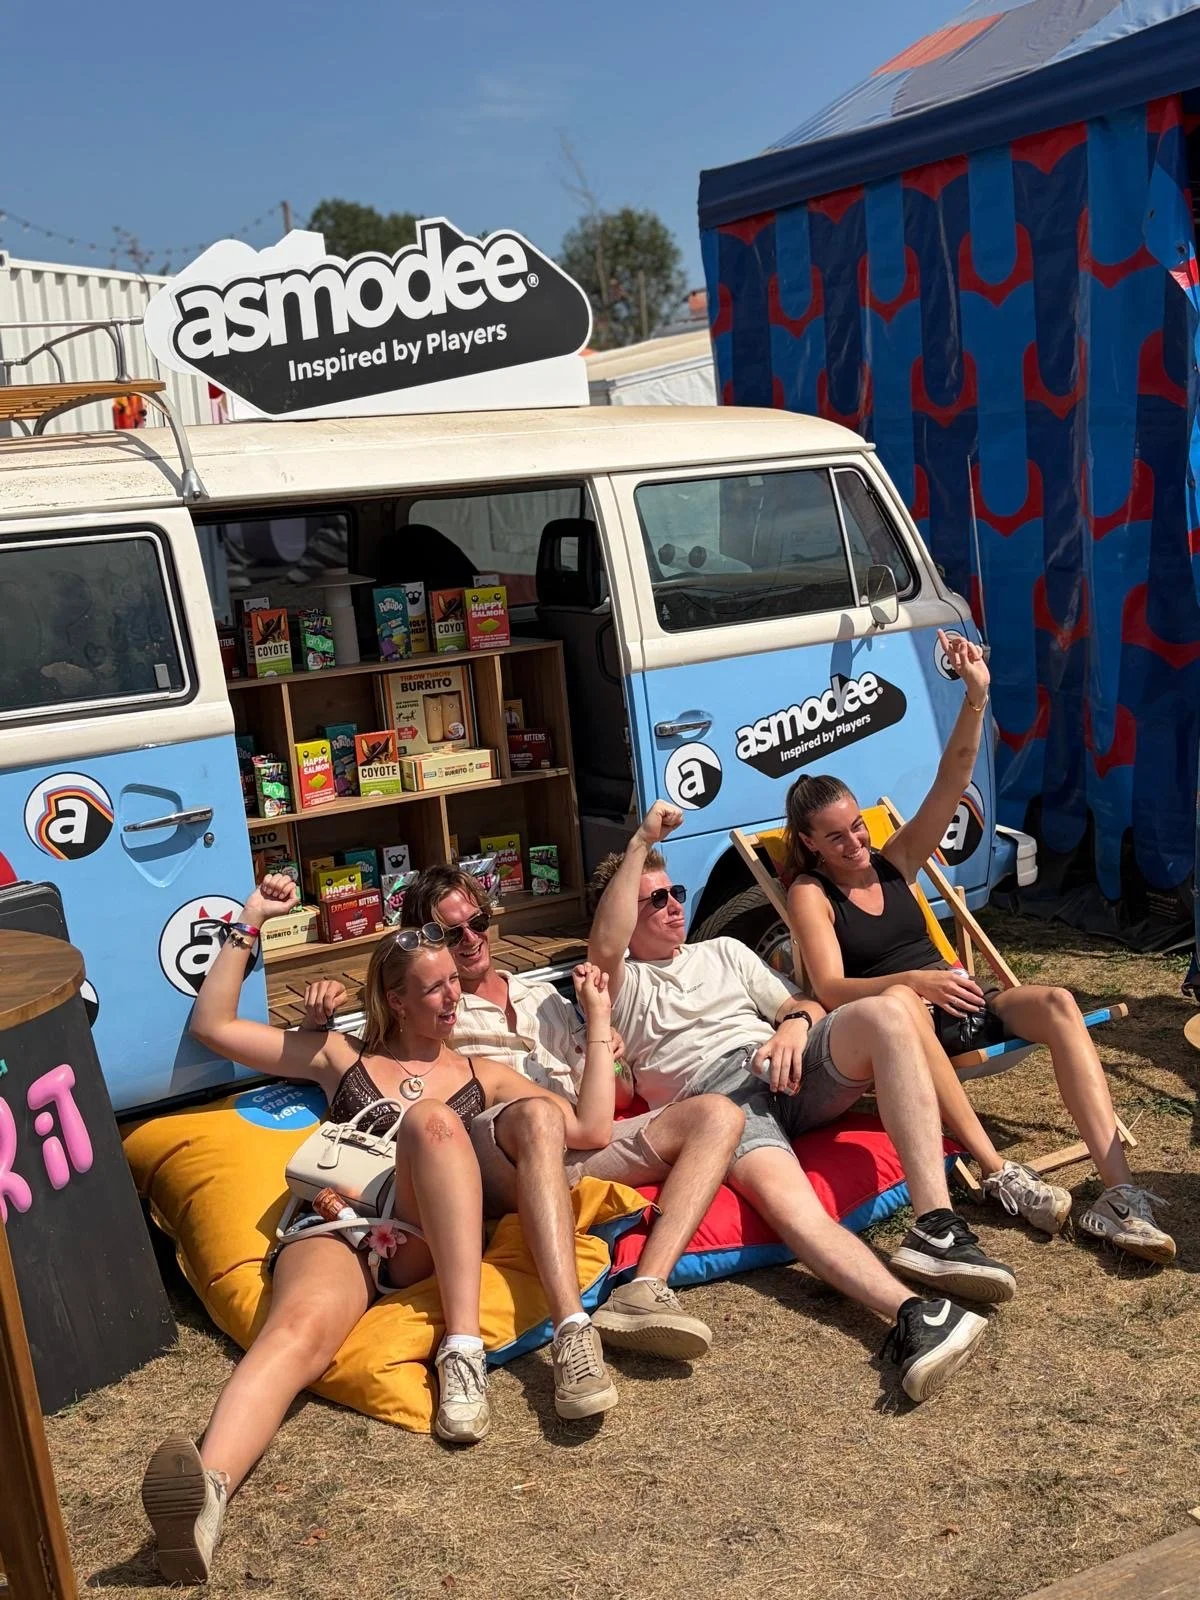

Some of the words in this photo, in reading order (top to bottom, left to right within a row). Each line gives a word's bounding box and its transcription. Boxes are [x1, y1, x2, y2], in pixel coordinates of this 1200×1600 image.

[288, 340, 388, 382] Inspired
[393, 337, 424, 366] by
[427, 322, 508, 355] Players
[471, 600, 503, 611] HAPPY
[472, 609, 505, 618] SALMON
[257, 643, 289, 657] COYOTE
[401, 678, 452, 692] BURRITO
[780, 735, 821, 762] Inspired
[822, 731, 835, 748] by
[835, 714, 871, 737] Players
[303, 755, 329, 768] HAPPY
[303, 763, 330, 775] SALMON
[361, 765, 397, 778] COYOTE
[679, 762, 706, 799] a
[49, 799, 89, 844] a
[326, 884, 357, 895] HAPPY
[262, 1090, 304, 1112] starts
